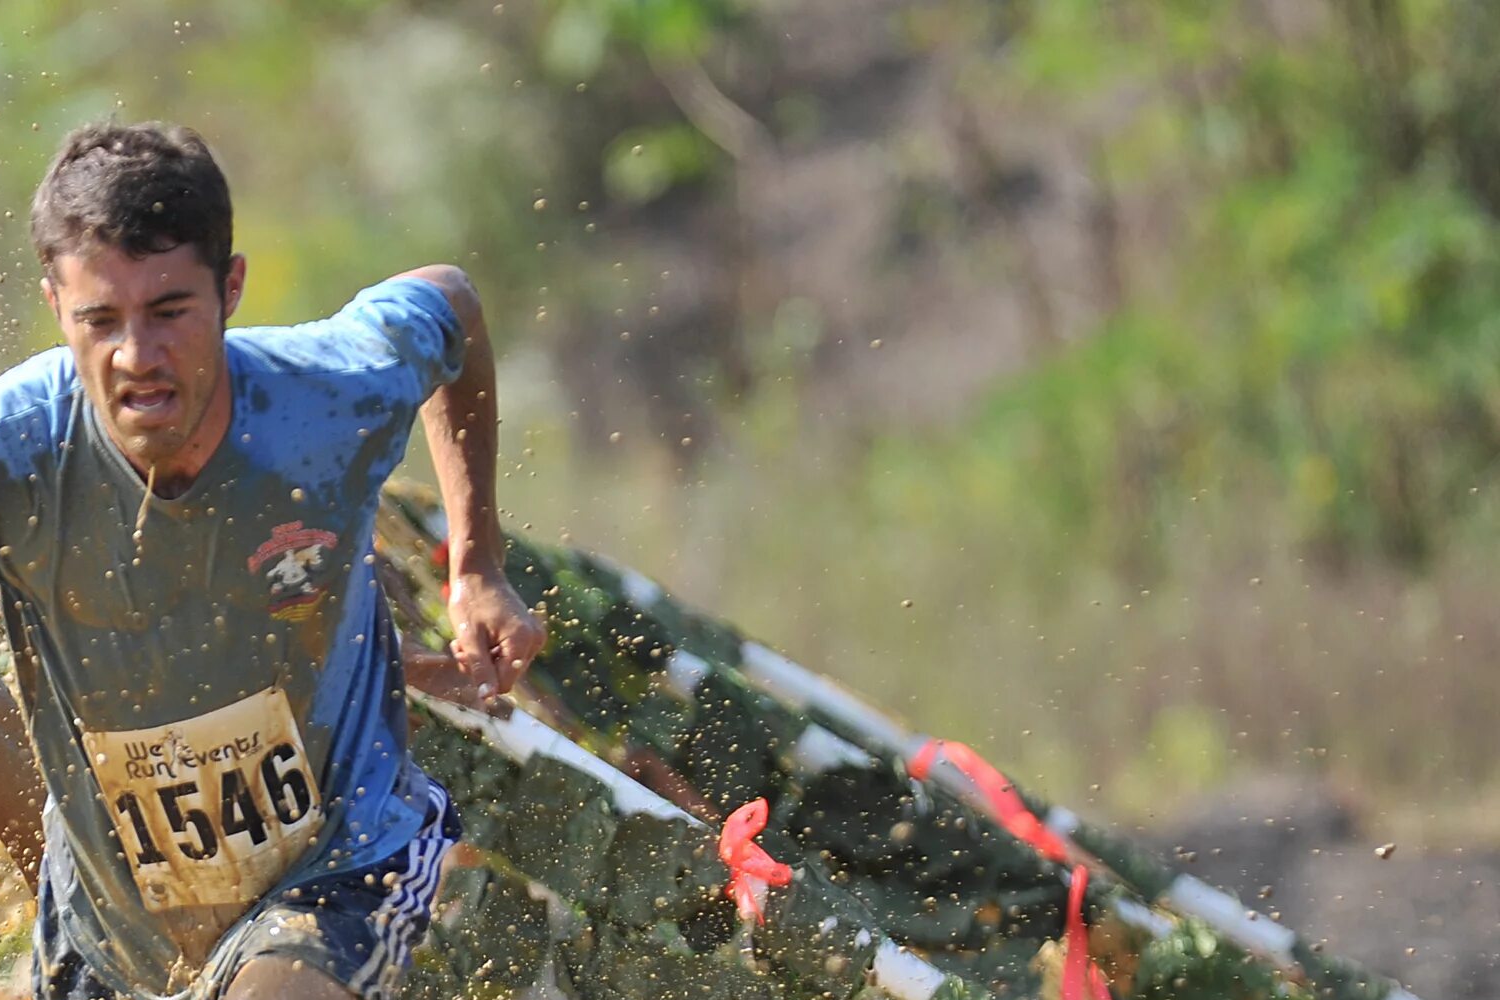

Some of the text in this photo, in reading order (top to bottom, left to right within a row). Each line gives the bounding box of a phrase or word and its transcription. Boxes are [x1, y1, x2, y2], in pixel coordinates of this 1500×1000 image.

[125, 741, 163, 760] We
[125, 761, 176, 779] Run
[116, 743, 310, 864] 1546
